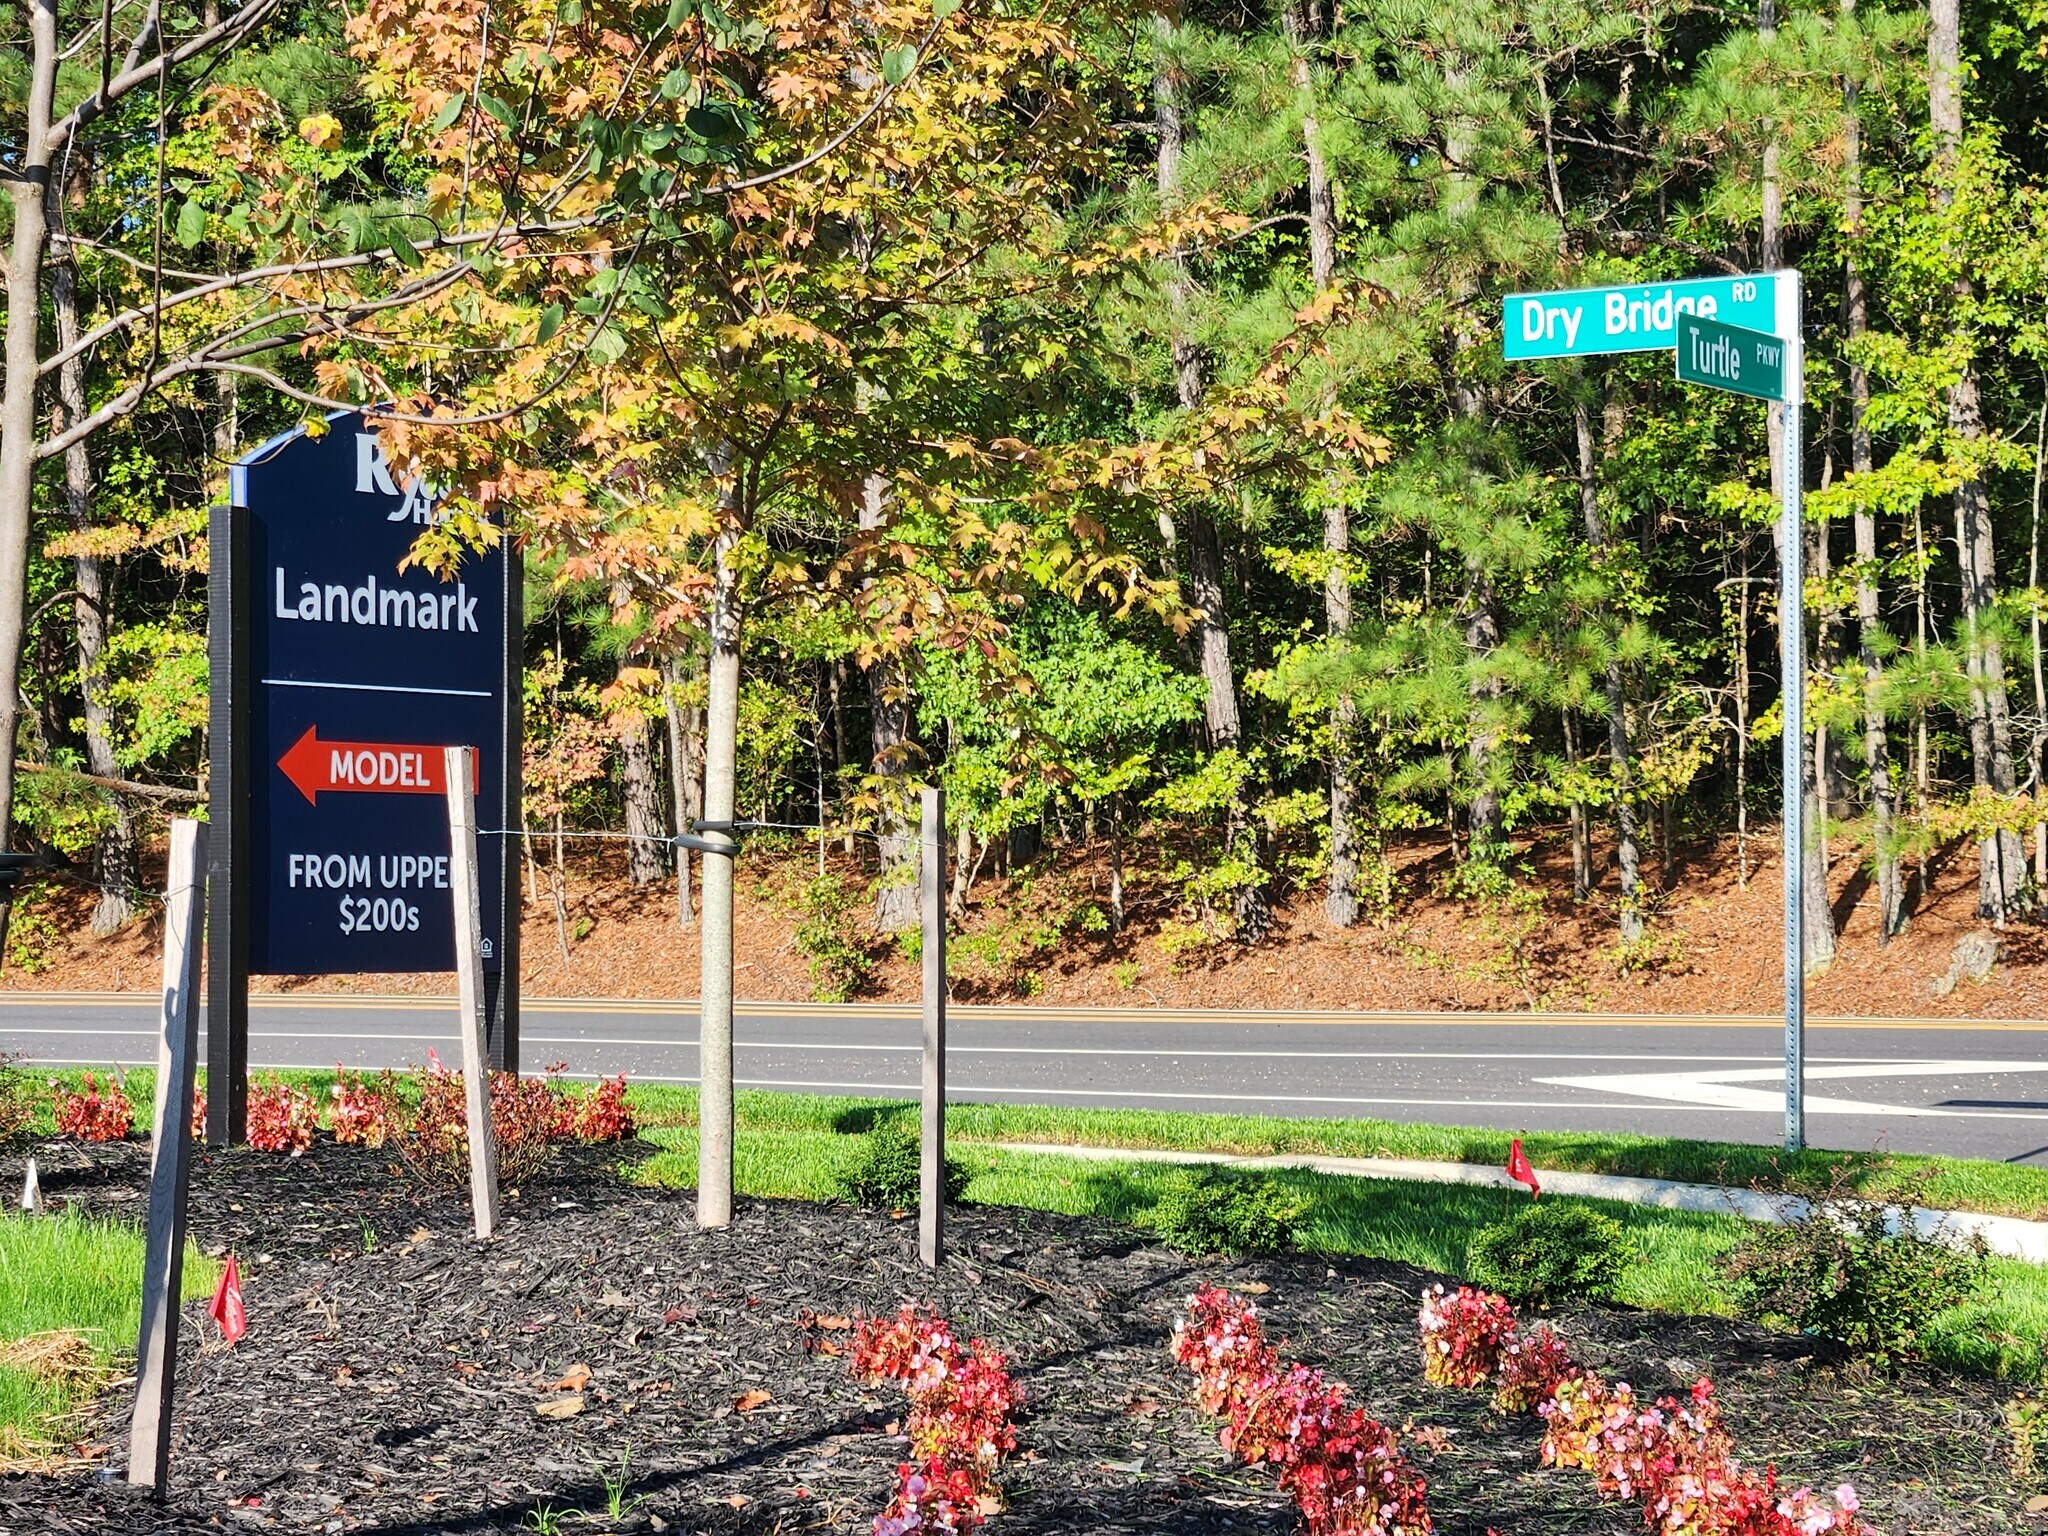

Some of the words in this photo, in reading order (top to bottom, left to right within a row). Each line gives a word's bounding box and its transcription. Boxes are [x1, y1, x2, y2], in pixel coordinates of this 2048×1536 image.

[1522, 299, 1583, 348] Dry
[1731, 281, 1757, 303] RD
[1689, 326, 1741, 381] Turtle
[1756, 342, 1781, 368] PKWY
[275, 566, 480, 633] Landmark
[330, 749, 431, 787] MODEL
[289, 853, 372, 889] FROM
[379, 855, 455, 890] UPPE
[339, 893, 420, 936] $200s
